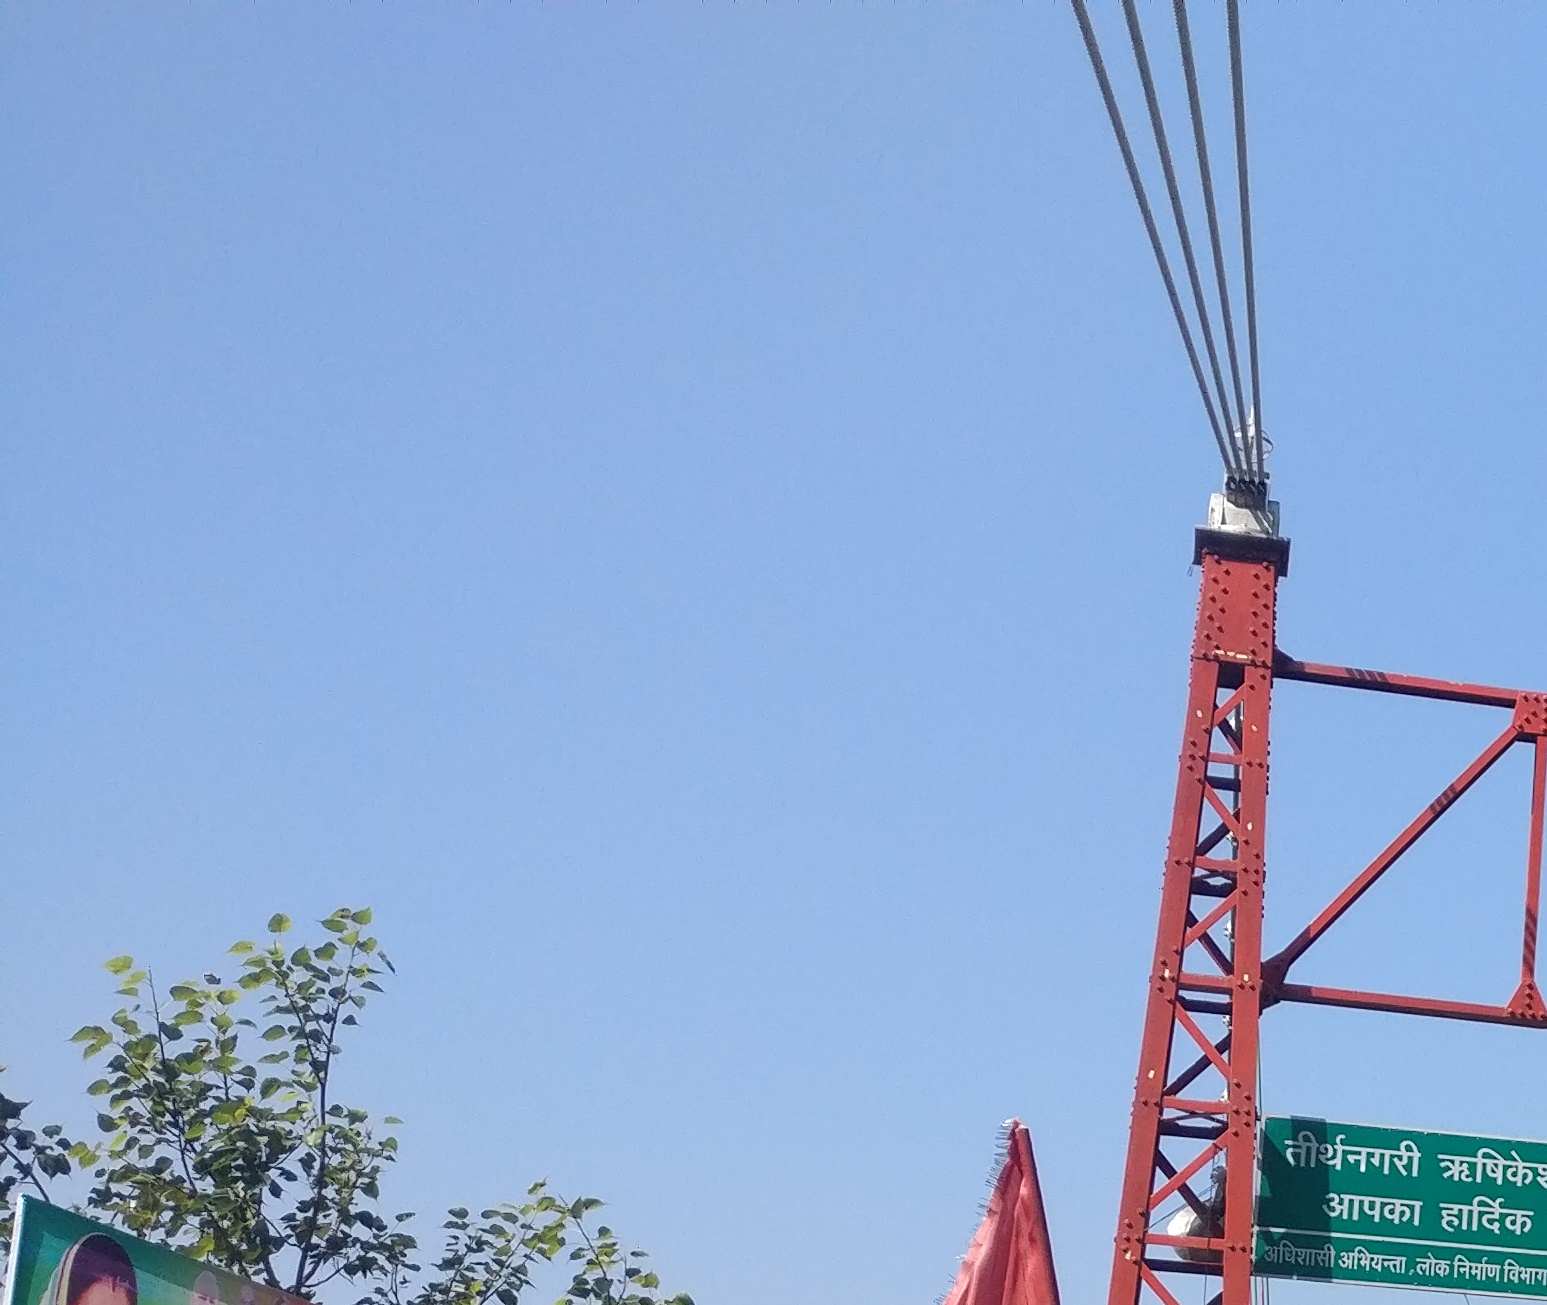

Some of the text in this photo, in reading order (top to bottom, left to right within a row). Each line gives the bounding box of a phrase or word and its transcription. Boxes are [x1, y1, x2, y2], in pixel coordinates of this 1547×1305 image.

[1284, 1131, 1421, 1178] तीर्थनगरी
[1322, 1191, 1422, 1226] आपका
[1440, 1196, 1534, 1236] हार्दिक
[1416, 1252, 1451, 1278] लोक
[1453, 1254, 1501, 1283] निर्माण
